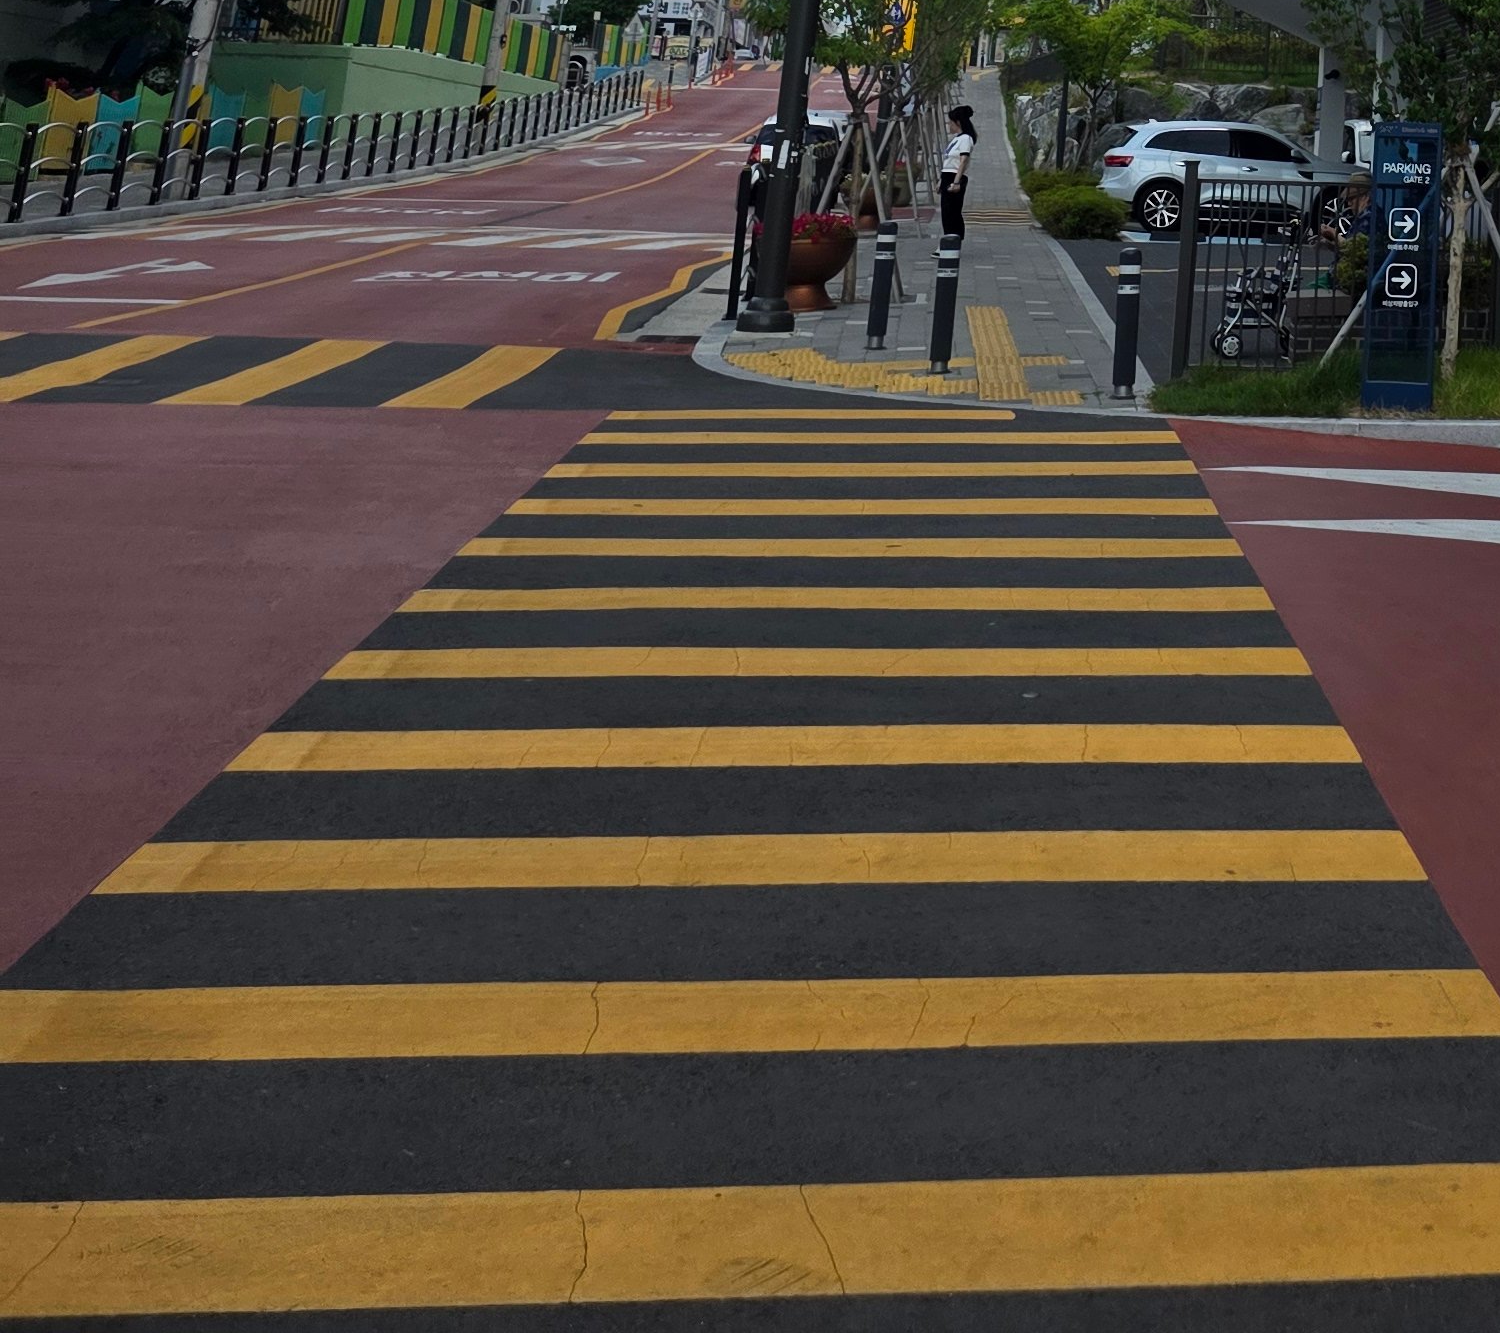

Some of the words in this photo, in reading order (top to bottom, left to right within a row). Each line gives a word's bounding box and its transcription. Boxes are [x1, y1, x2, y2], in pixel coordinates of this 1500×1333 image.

[1383, 162, 1431, 175] PARKING
[1403, 176, 1423, 184] GATE
[1424, 176, 1431, 184] 2
